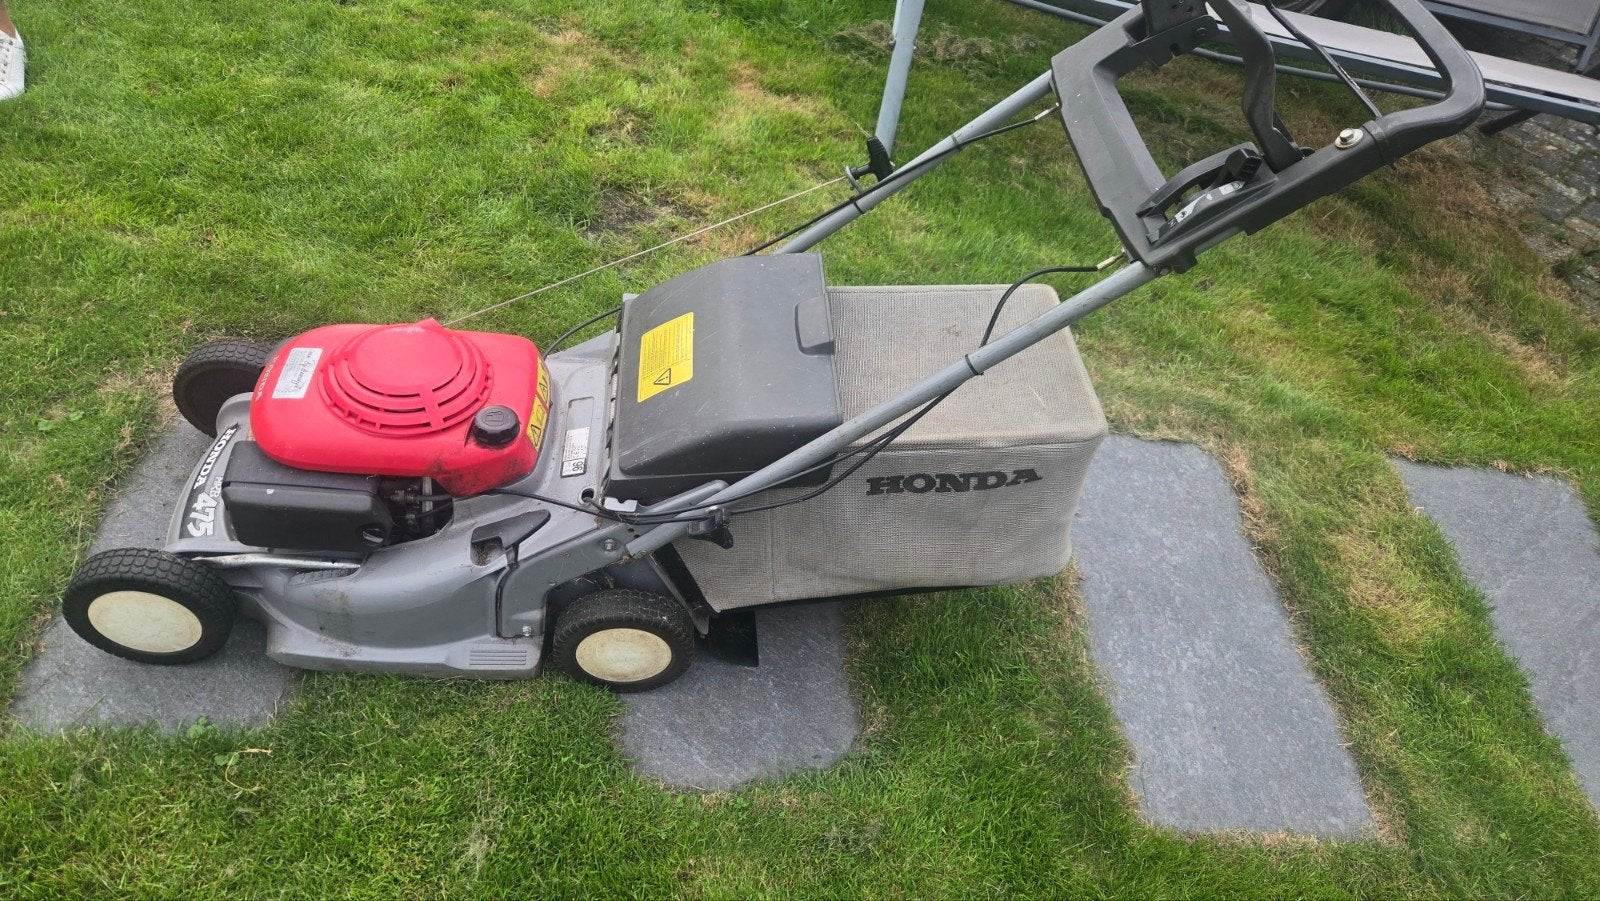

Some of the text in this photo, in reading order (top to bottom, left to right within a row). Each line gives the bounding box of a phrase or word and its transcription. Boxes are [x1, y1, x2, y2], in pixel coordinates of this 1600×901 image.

[193, 428, 236, 490] HONDA
[865, 468, 1043, 496] HONDA
[187, 491, 218, 537] 475
